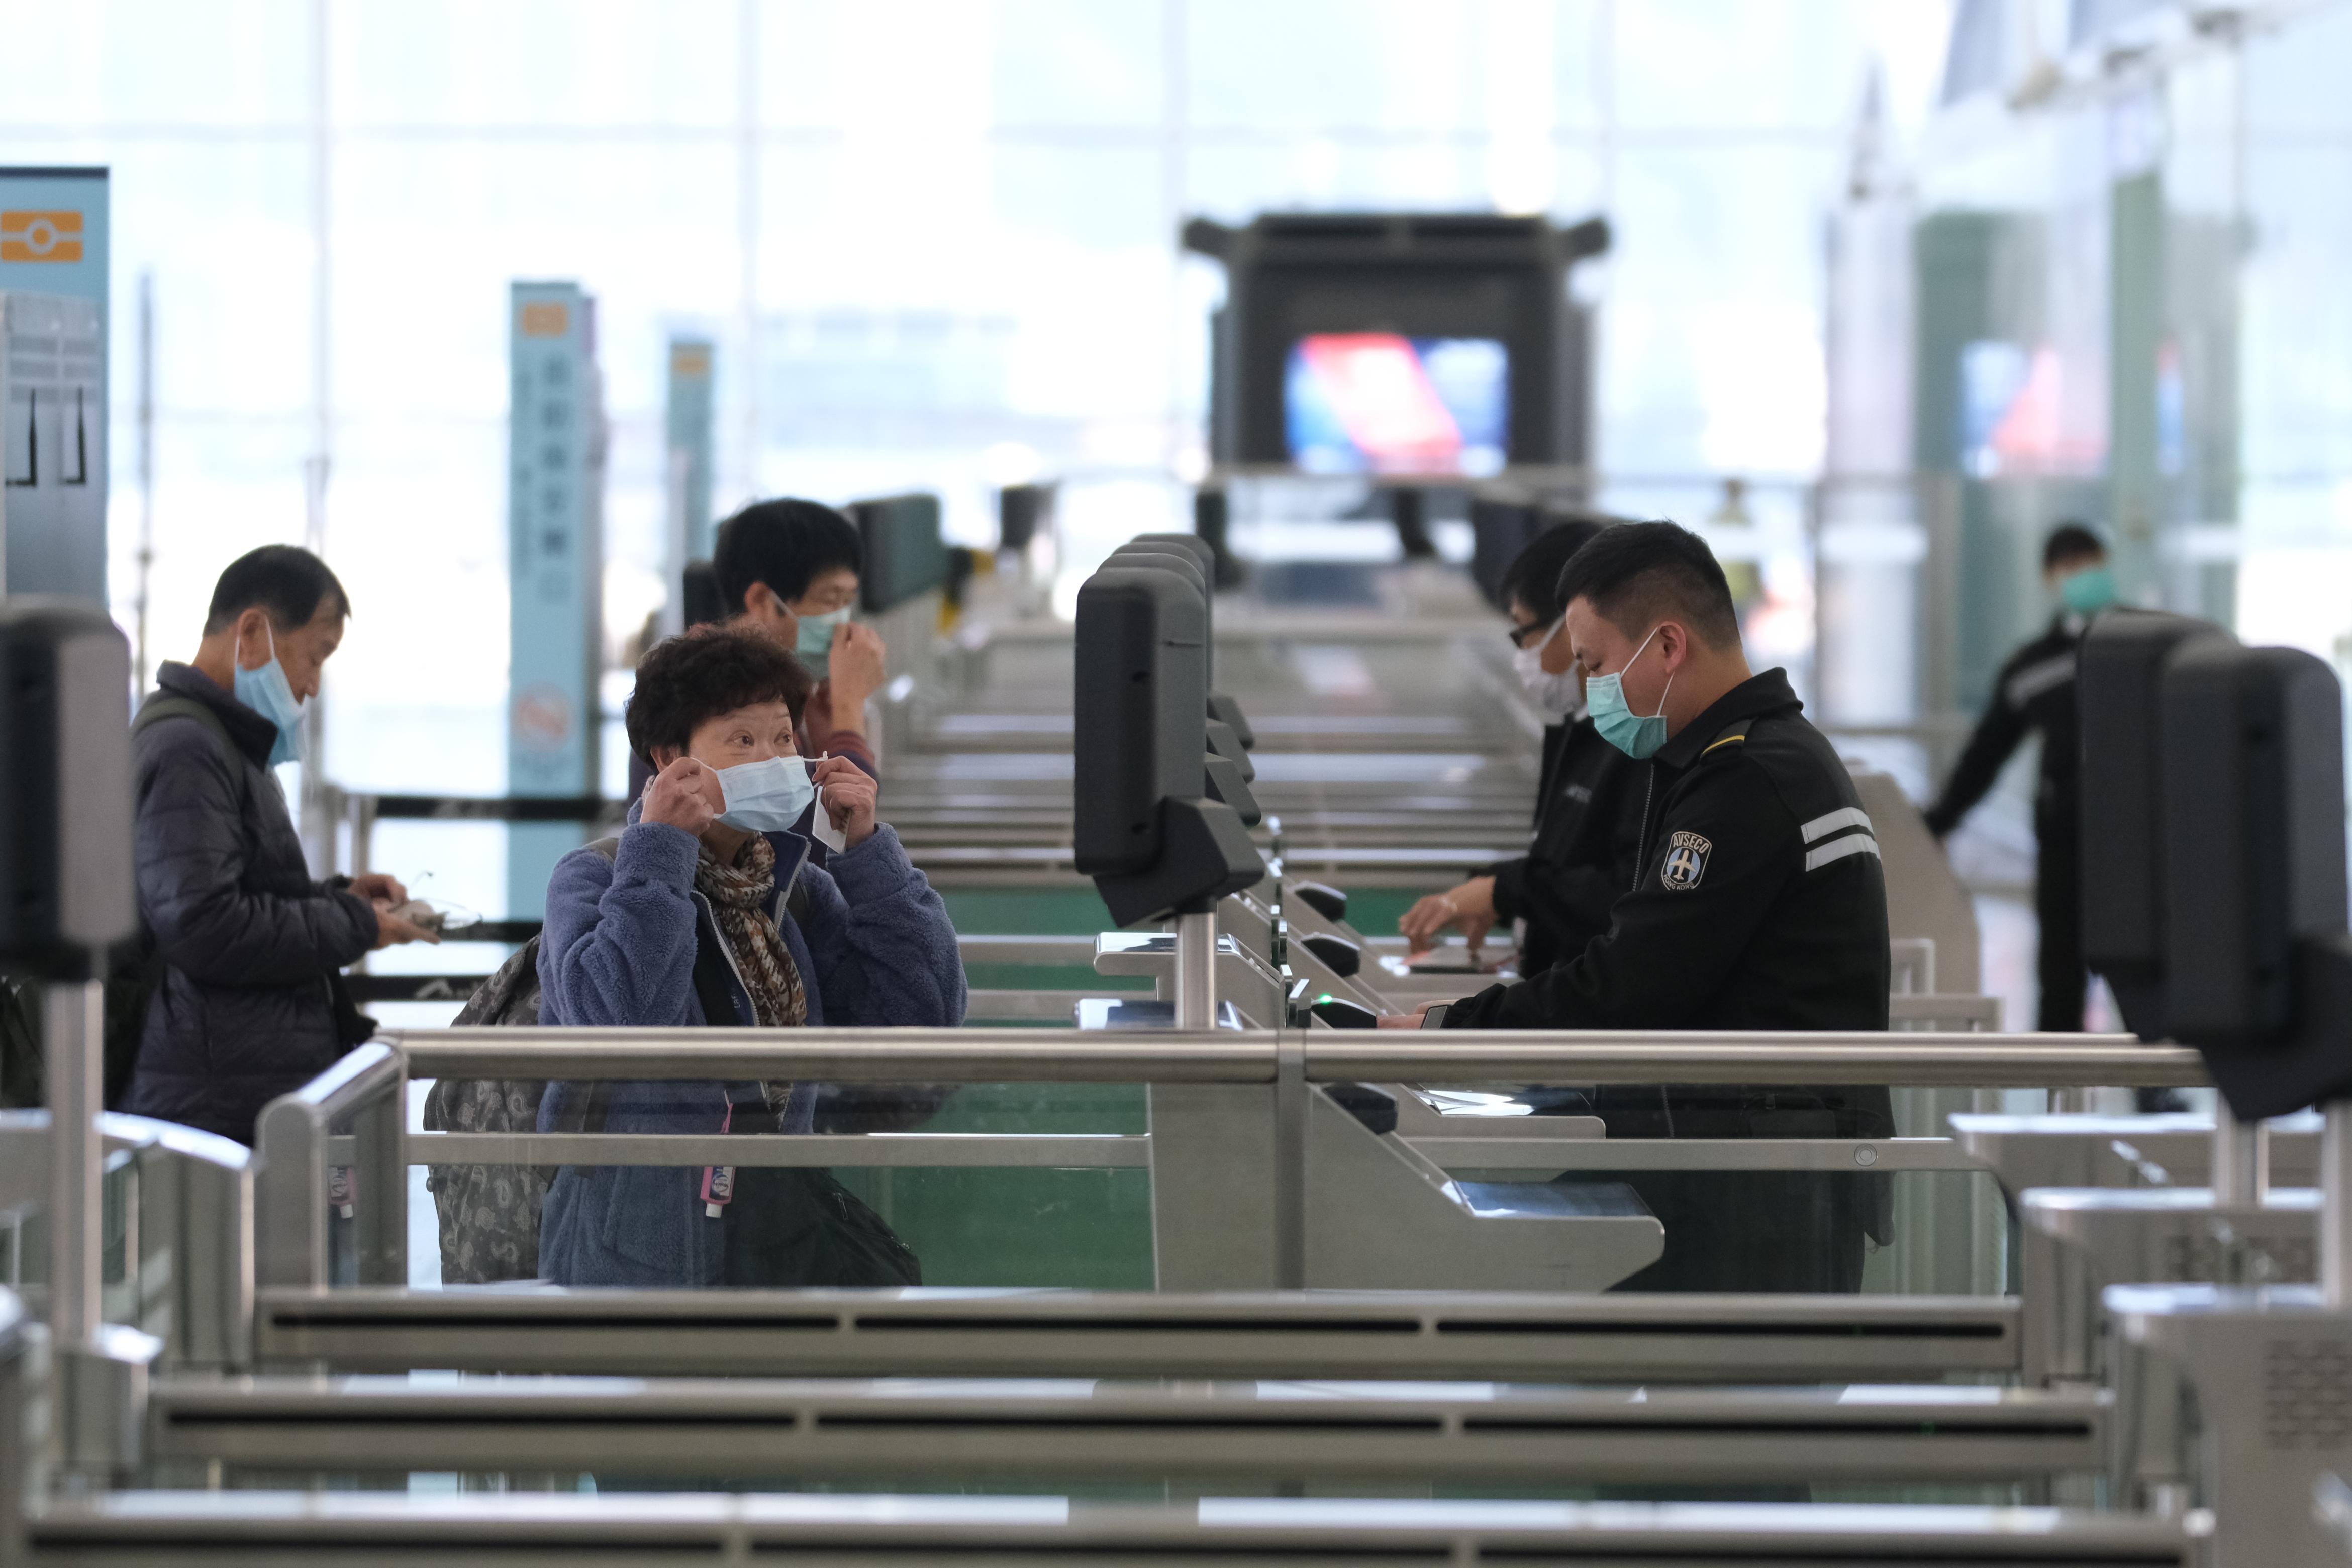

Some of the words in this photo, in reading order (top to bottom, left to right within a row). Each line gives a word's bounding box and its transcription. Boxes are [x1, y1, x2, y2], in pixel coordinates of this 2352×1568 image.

[1673, 834, 1709, 854] AVSECO
[1663, 874, 1676, 890] HONG
[1677, 881, 1694, 890] KONG
